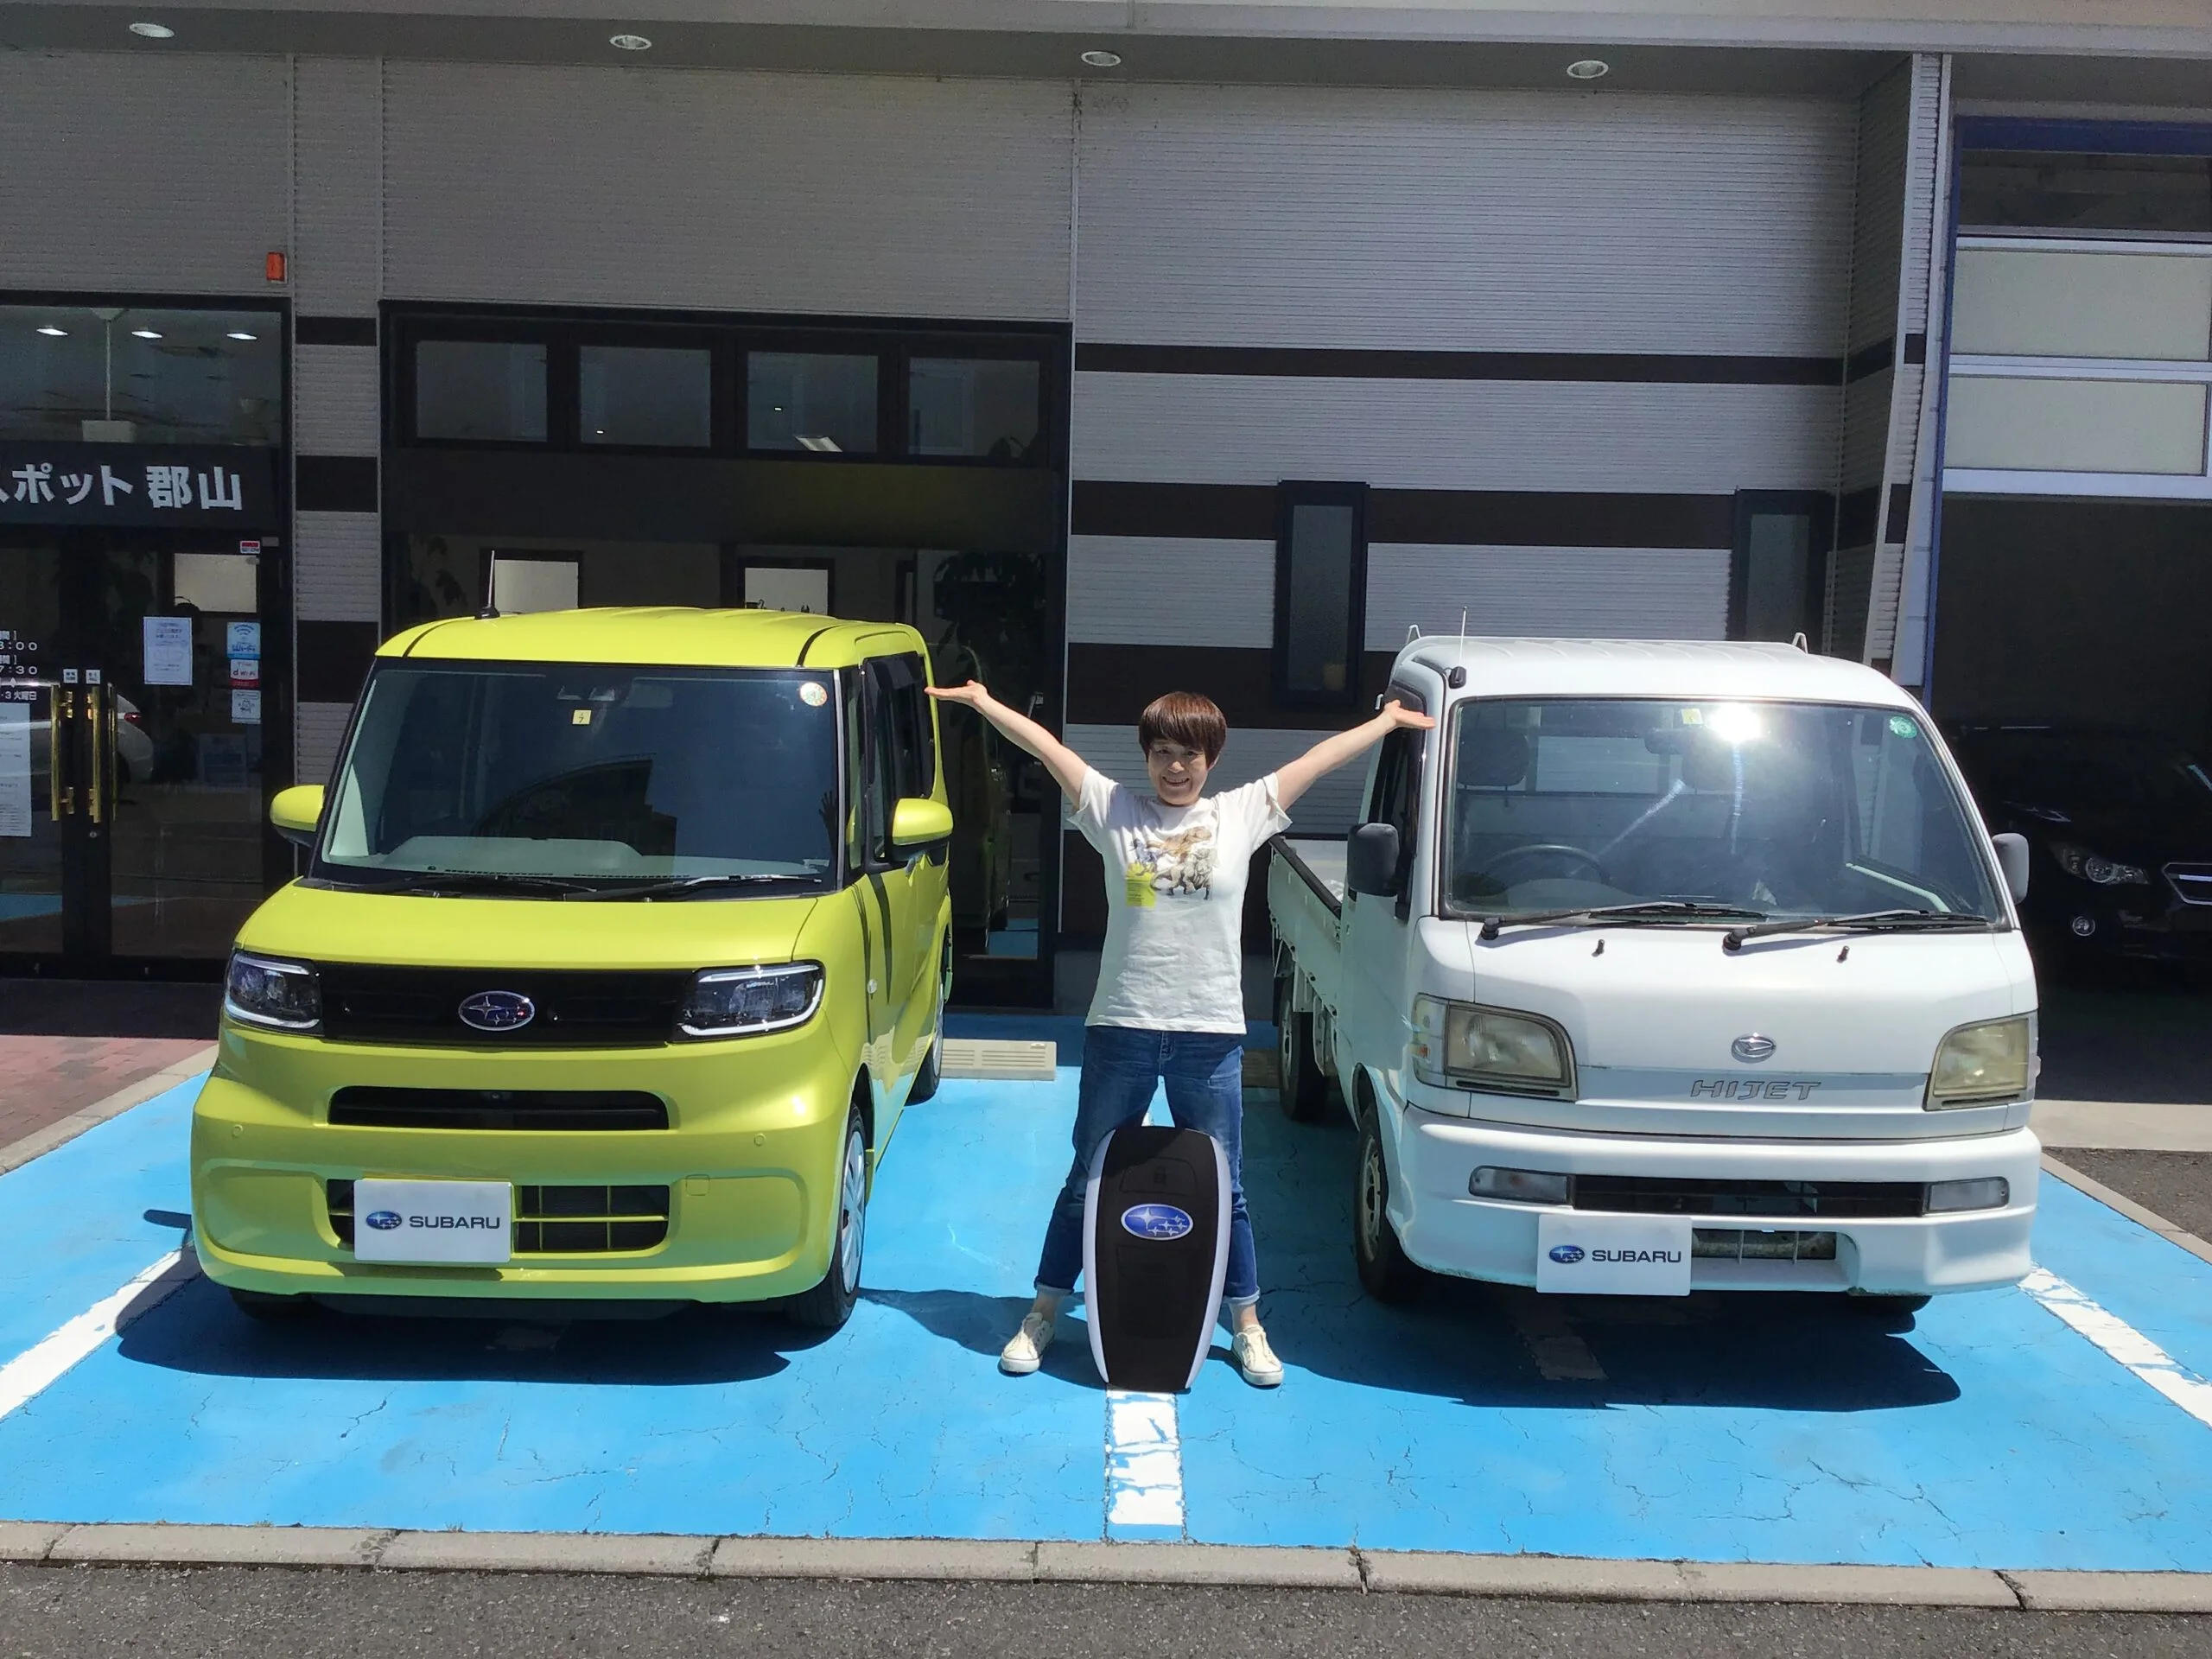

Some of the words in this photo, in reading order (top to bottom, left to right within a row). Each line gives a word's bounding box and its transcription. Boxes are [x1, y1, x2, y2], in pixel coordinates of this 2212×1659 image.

[0, 462, 134, 506] ポット
[146, 466, 244, 511] 郡山
[1690, 1079, 1822, 1101] HIJET
[409, 1215, 500, 1230] SUBARU
[1592, 1249, 1681, 1263] SUBARU
